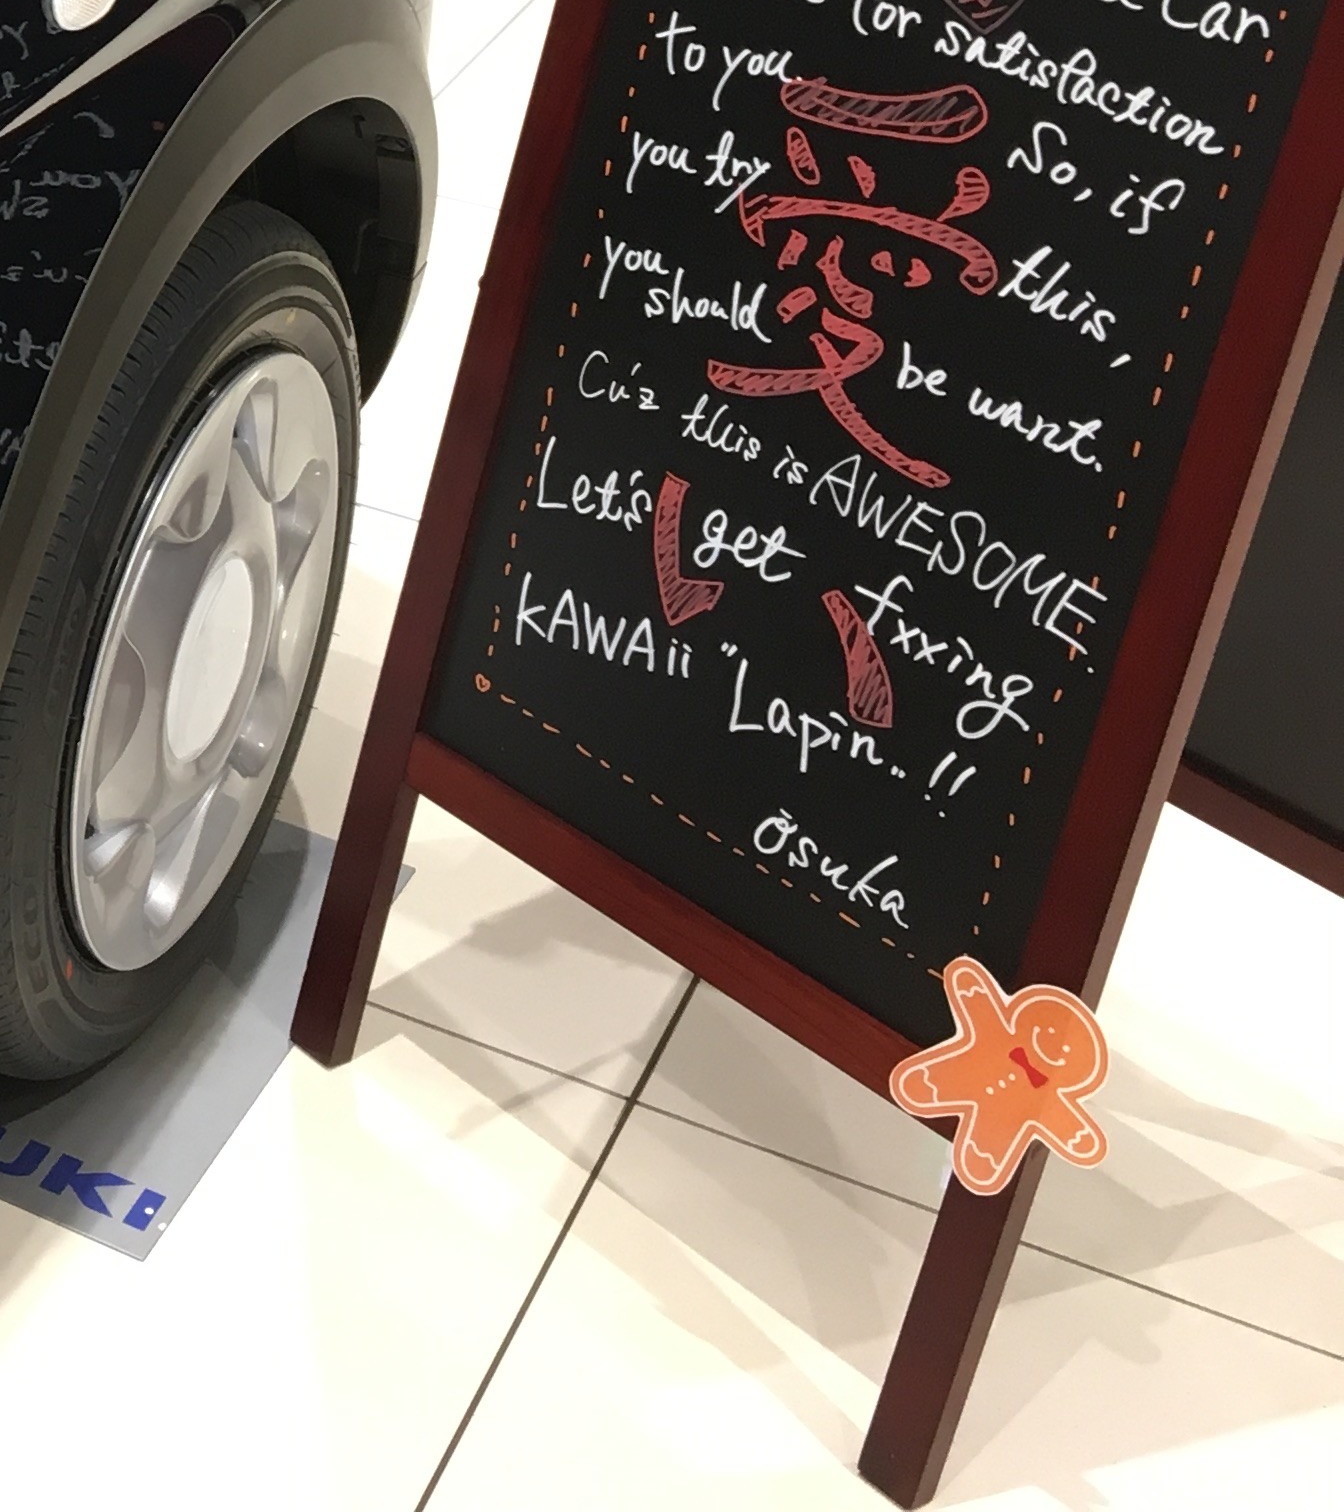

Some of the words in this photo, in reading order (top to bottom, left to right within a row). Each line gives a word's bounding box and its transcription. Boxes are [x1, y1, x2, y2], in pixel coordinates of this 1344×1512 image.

[653, 9, 707, 77] to
[1005, 120, 1094, 203] So,
[1108, 172, 1187, 236] if
[933, 19, 1226, 156] satisfaction
[597, 234, 671, 301] you
[643, 266, 773, 345] should
[895, 340, 949, 398] be
[625, 130, 699, 195] you
[702, 129, 773, 215] try
[996, 244, 1132, 369] this,
[535, 434, 654, 533] Let's
[691, 507, 808, 584] get
[679, 392, 762, 463] this
[771, 443, 810, 486] is
